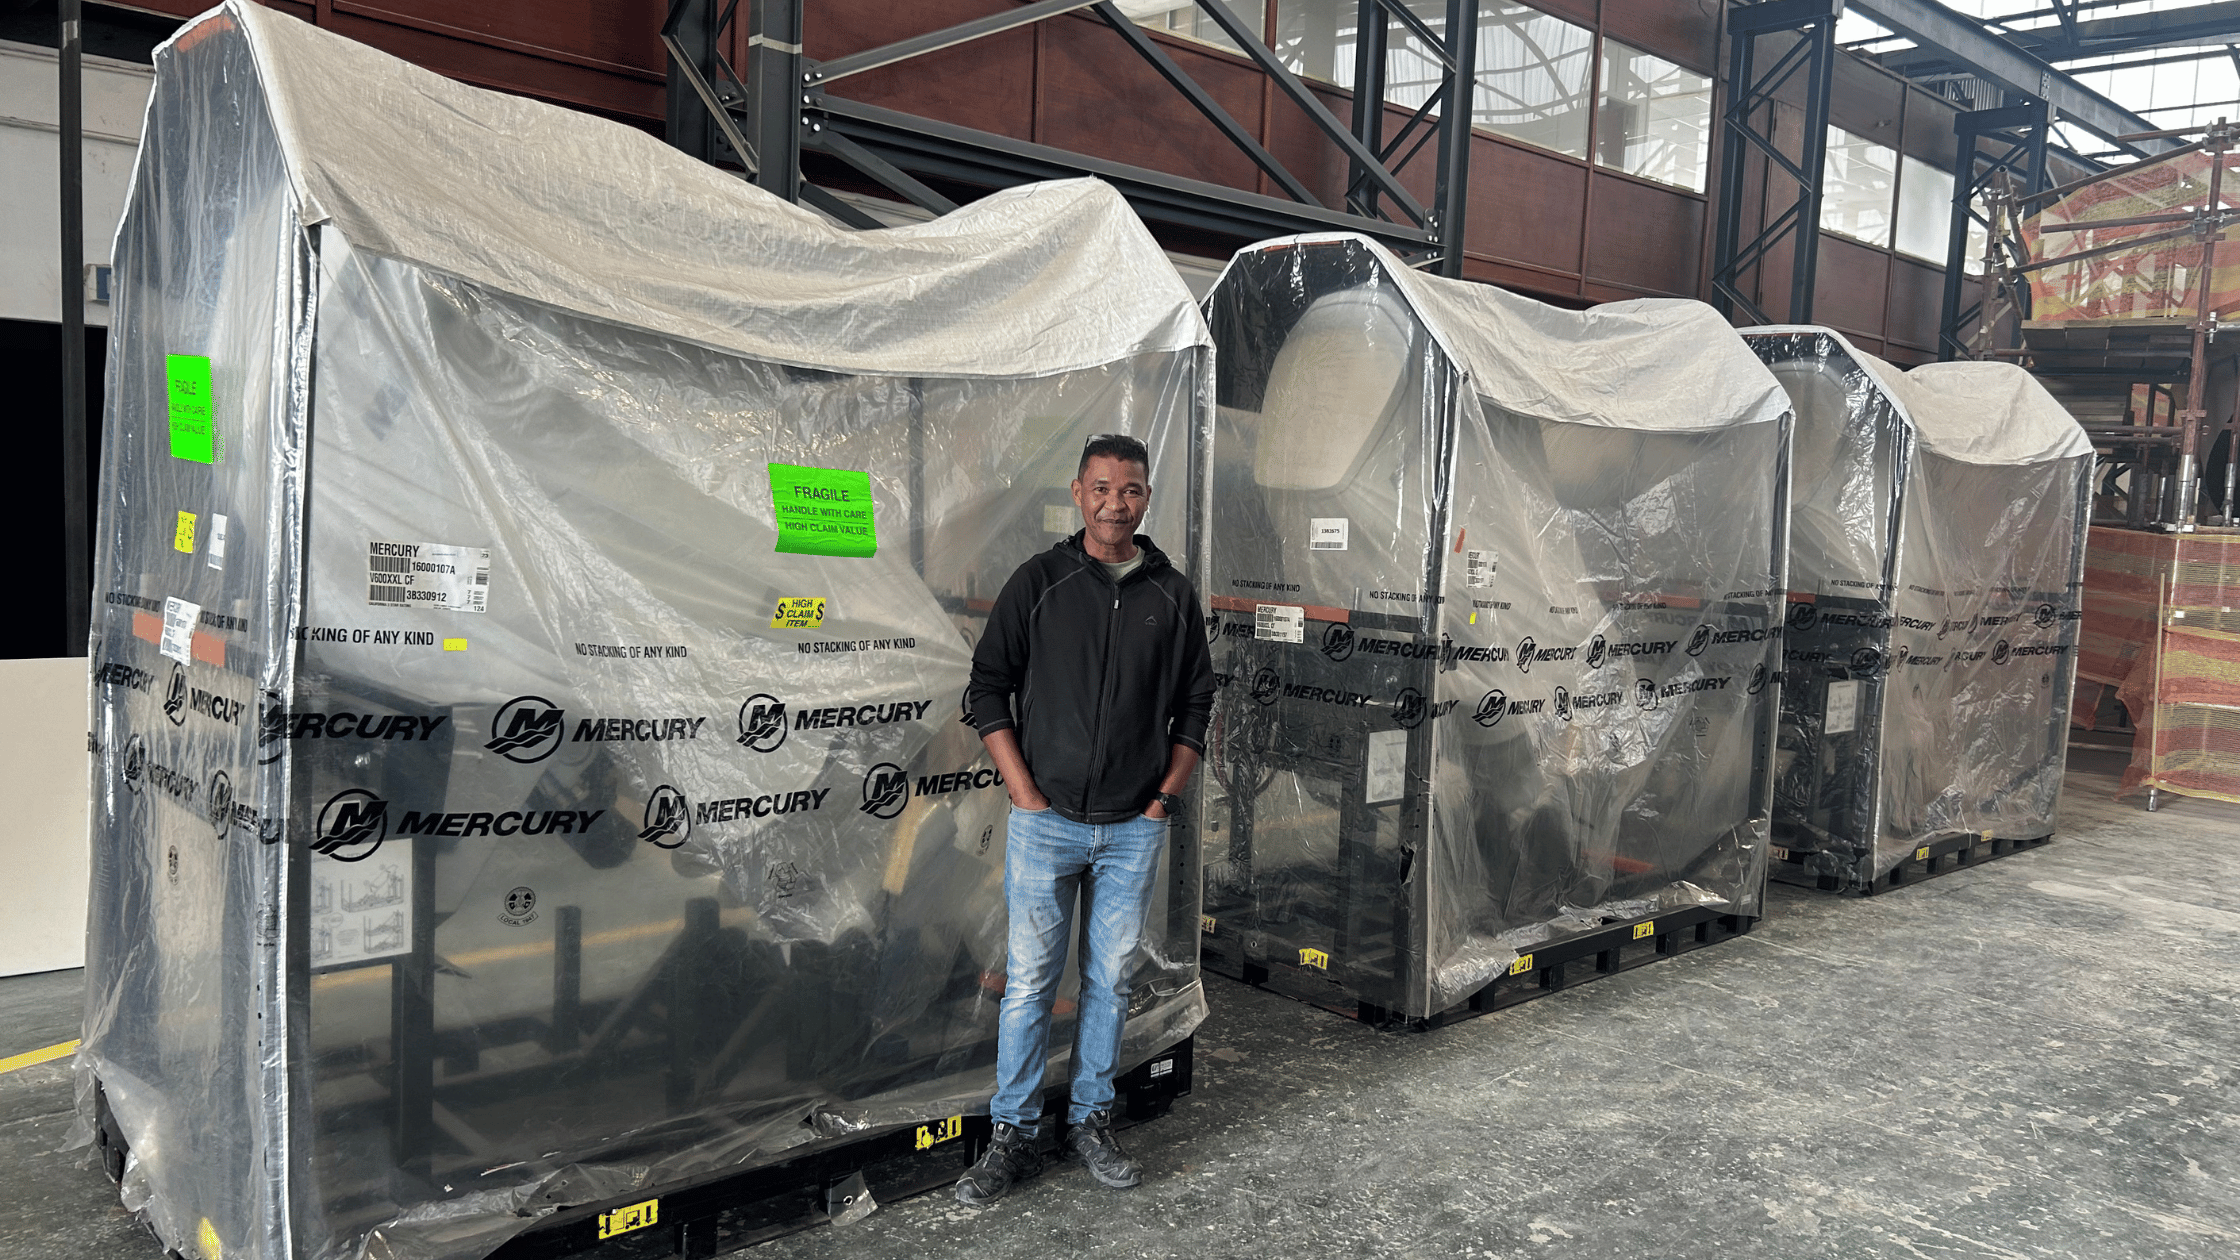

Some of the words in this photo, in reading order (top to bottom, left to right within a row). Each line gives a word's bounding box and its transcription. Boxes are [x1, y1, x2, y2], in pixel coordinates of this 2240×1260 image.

[794, 486, 850, 502] FRAGILE
[782, 505, 818, 516] HANDLE
[820, 508, 842, 517] WITH
[844, 509, 868, 519] CARE
[785, 522, 808, 531] HIGH
[810, 523, 838, 533] CLAIM
[840, 526, 868, 535] VALUE
[370, 542, 420, 557] MERCURY
[411, 561, 455, 575] 16000107A
[370, 572, 402, 585] V600XXL
[404, 574, 415, 585] CF
[1840, 580, 1865, 588] STACKING
[1286, 584, 1300, 592] KIND
[792, 599, 813, 608] HIGH
[1370, 591, 1378, 599] NO
[1380, 591, 1410, 601] STACKING
[786, 610, 814, 618] CLAIM
[352, 629, 370, 643] OF
[374, 631, 400, 645] ANY
[404, 631, 434, 645] KIND
[1711, 626, 1783, 644] MERCURY
[575, 643, 587, 656] NO
[589, 645, 627, 658] STACKING
[629, 647, 641, 658] OF
[644, 647, 662, 658] ANY
[665, 646, 687, 658] KIND
[798, 643, 811, 653] NO
[813, 641, 856, 653] STACKING
[859, 640, 871, 651] OF
[873, 639, 890, 650] ANY
[894, 637, 915, 649] KIND
[1357, 637, 1440, 659] MERCUR
[1608, 641, 1678, 657] MERCURY
[2011, 645, 2068, 657] MERCURY
[1533, 647, 1577, 661] MERCURY
[1906, 655, 1943, 665] MERCURY
[1661, 677, 1732, 698] MERCURY
[1283, 683, 1373, 708] MERCURY
[1572, 692, 1623, 709] MERCURY
[794, 700, 932, 730] MERCURY
[283, 712, 448, 741] ERCURY
[571, 717, 706, 742] MERCURY
[915, 768, 1006, 797] MERCU
[696, 788, 831, 825] MERCURY
[396, 810, 605, 836] MERCURY
[500, 915, 520, 925] LOCAL
